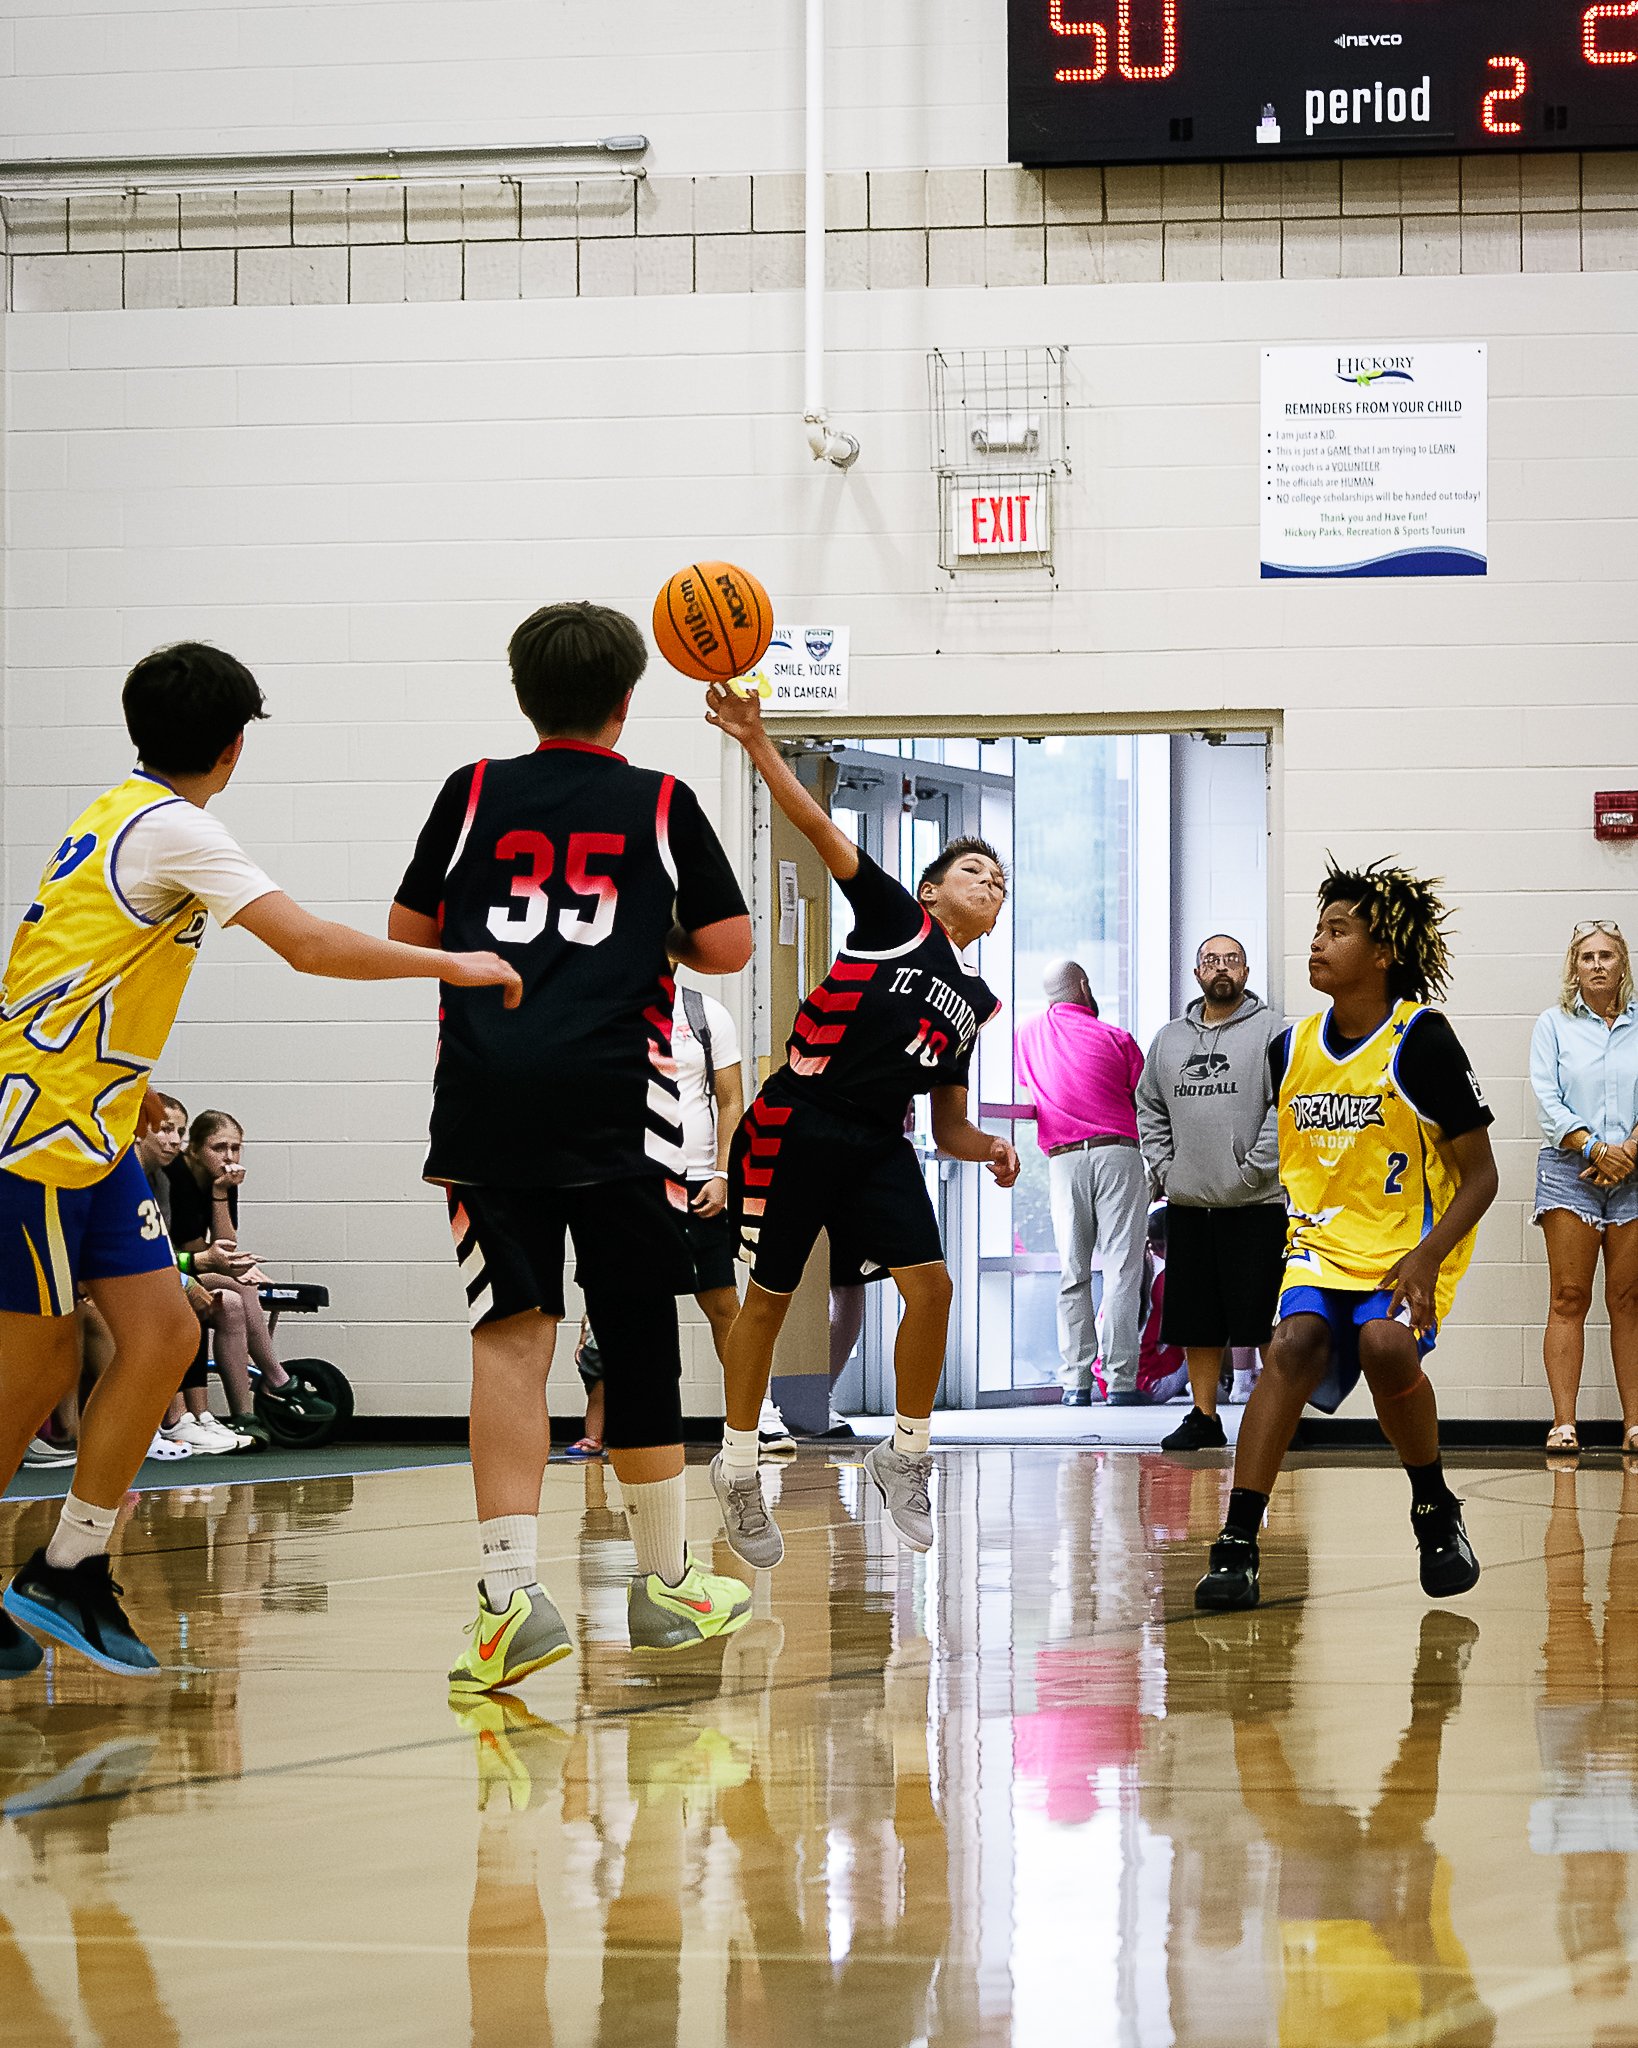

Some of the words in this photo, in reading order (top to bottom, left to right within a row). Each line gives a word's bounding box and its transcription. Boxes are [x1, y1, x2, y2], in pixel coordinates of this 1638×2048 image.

[1050, 0, 1176, 81] 50
[1305, 76, 1431, 136] period
[1482, 56, 1526, 133] 2
[1336, 356, 1414, 374] HICKORY
[1285, 402, 1352, 415] REMINDERS
[1355, 401, 1389, 414] FROM
[1392, 401, 1424, 413] YOUR
[1427, 400, 1463, 413] CHILD
[1281, 432, 1294, 440] am
[1295, 431, 1312, 442] just
[1313, 432, 1318, 440] a
[1276, 446, 1292, 456] This
[1294, 447, 1301, 456] is
[1302, 447, 1318, 458] just
[1327, 445, 1352, 456] GAME
[1353, 445, 1370, 455] that
[1392, 444, 1417, 456] trying
[1418, 446, 1427, 454] to
[1276, 463, 1289, 474] My
[1291, 462, 1315, 472] coach
[1316, 463, 1323, 471] is
[1276, 478, 1291, 488] The
[1292, 477, 1324, 487] officials
[1325, 479, 1339, 487] are
[1276, 494, 1289, 504] NO
[1291, 493, 1322, 505] college
[1323, 492, 1374, 504] scholarships
[1376, 491, 1391, 501] will
[1392, 492, 1403, 501] be
[1405, 491, 1437, 501] handed
[1438, 491, 1453, 501] out
[1454, 490, 1481, 503] today!
[971, 495, 1031, 544] EXIT
[1320, 512, 1346, 523] Thank
[1348, 514, 1364, 525] you
[1366, 512, 1382, 523] and
[1384, 512, 1406, 522] Have
[1408, 511, 1428, 522] Fun!
[1283, 527, 1317, 540] Hickory
[1319, 527, 1345, 537] Parks,
[1346, 527, 1392, 536] Recreation
[1393, 527, 1400, 536] &
[1403, 526, 1430, 538] Sports
[1432, 525, 1466, 535] Tourism
[680, 578, 719, 656] Wilson
[774, 663, 806, 677] SMILE,
[808, 663, 842, 676] YOU'RE
[777, 686, 791, 698] ON
[794, 686, 837, 699] CAMERA!
[486, 829, 626, 947] 35
[888, 967, 924, 995] TC
[904, 1017, 949, 1068] 10
[1173, 1081, 1239, 1098] FOOTBALL
[1383, 1151, 1410, 1196] 2
